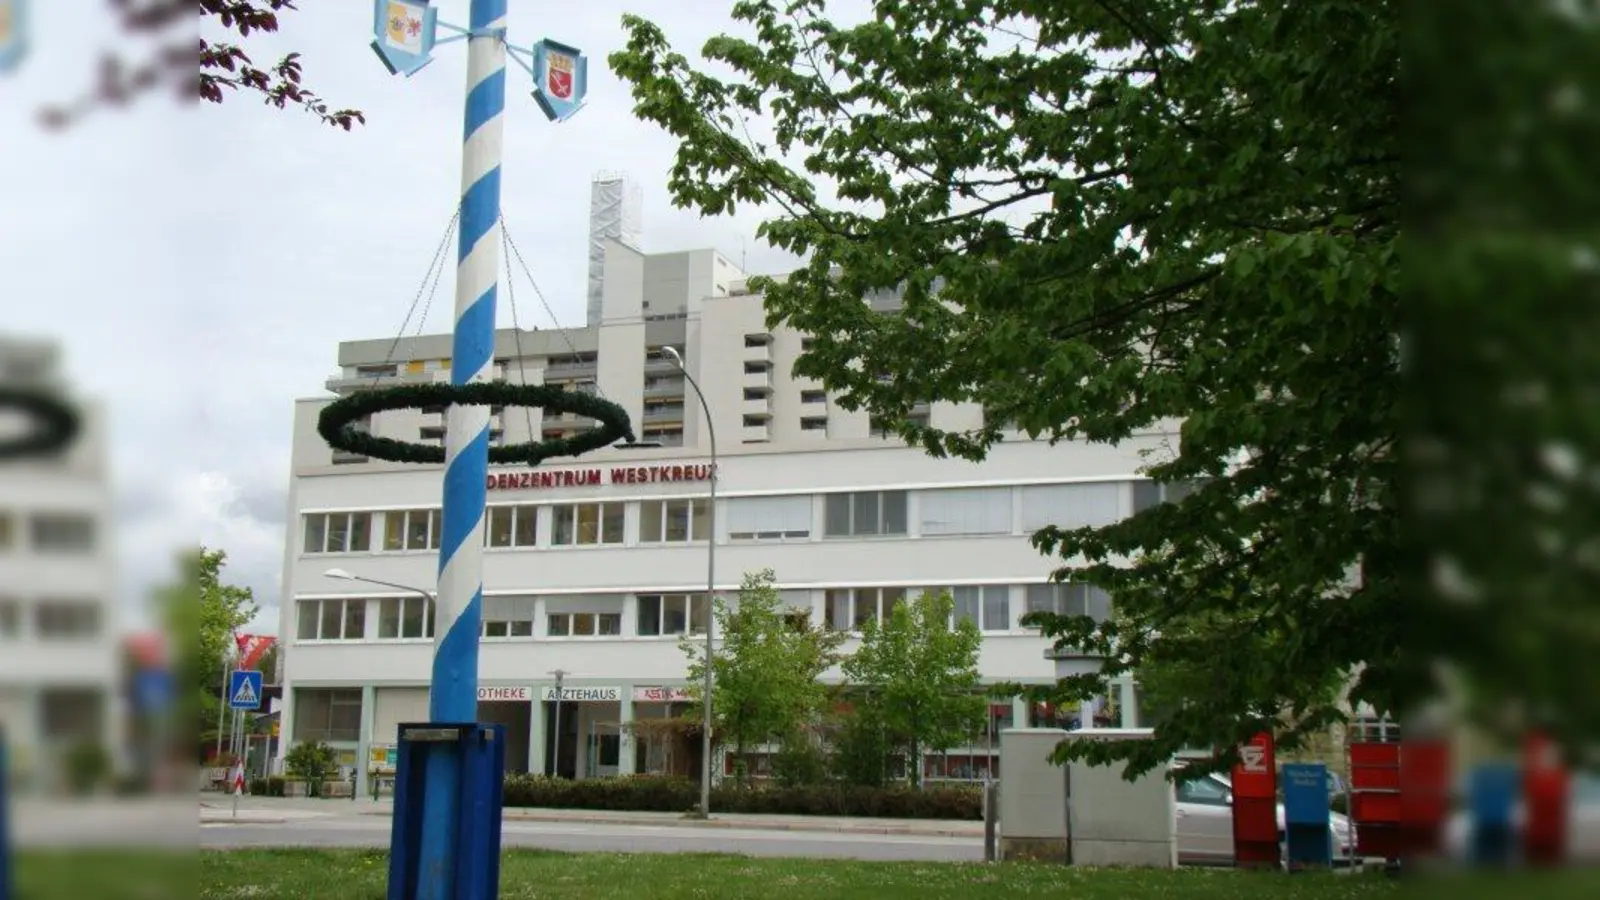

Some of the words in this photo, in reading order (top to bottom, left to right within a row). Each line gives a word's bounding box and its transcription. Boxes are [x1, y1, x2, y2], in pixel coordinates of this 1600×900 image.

[487, 469, 601, 490] DENZENTRUM
[611, 464, 718, 482] WESTKREUZ
[478, 687, 526, 700] OTHEKE
